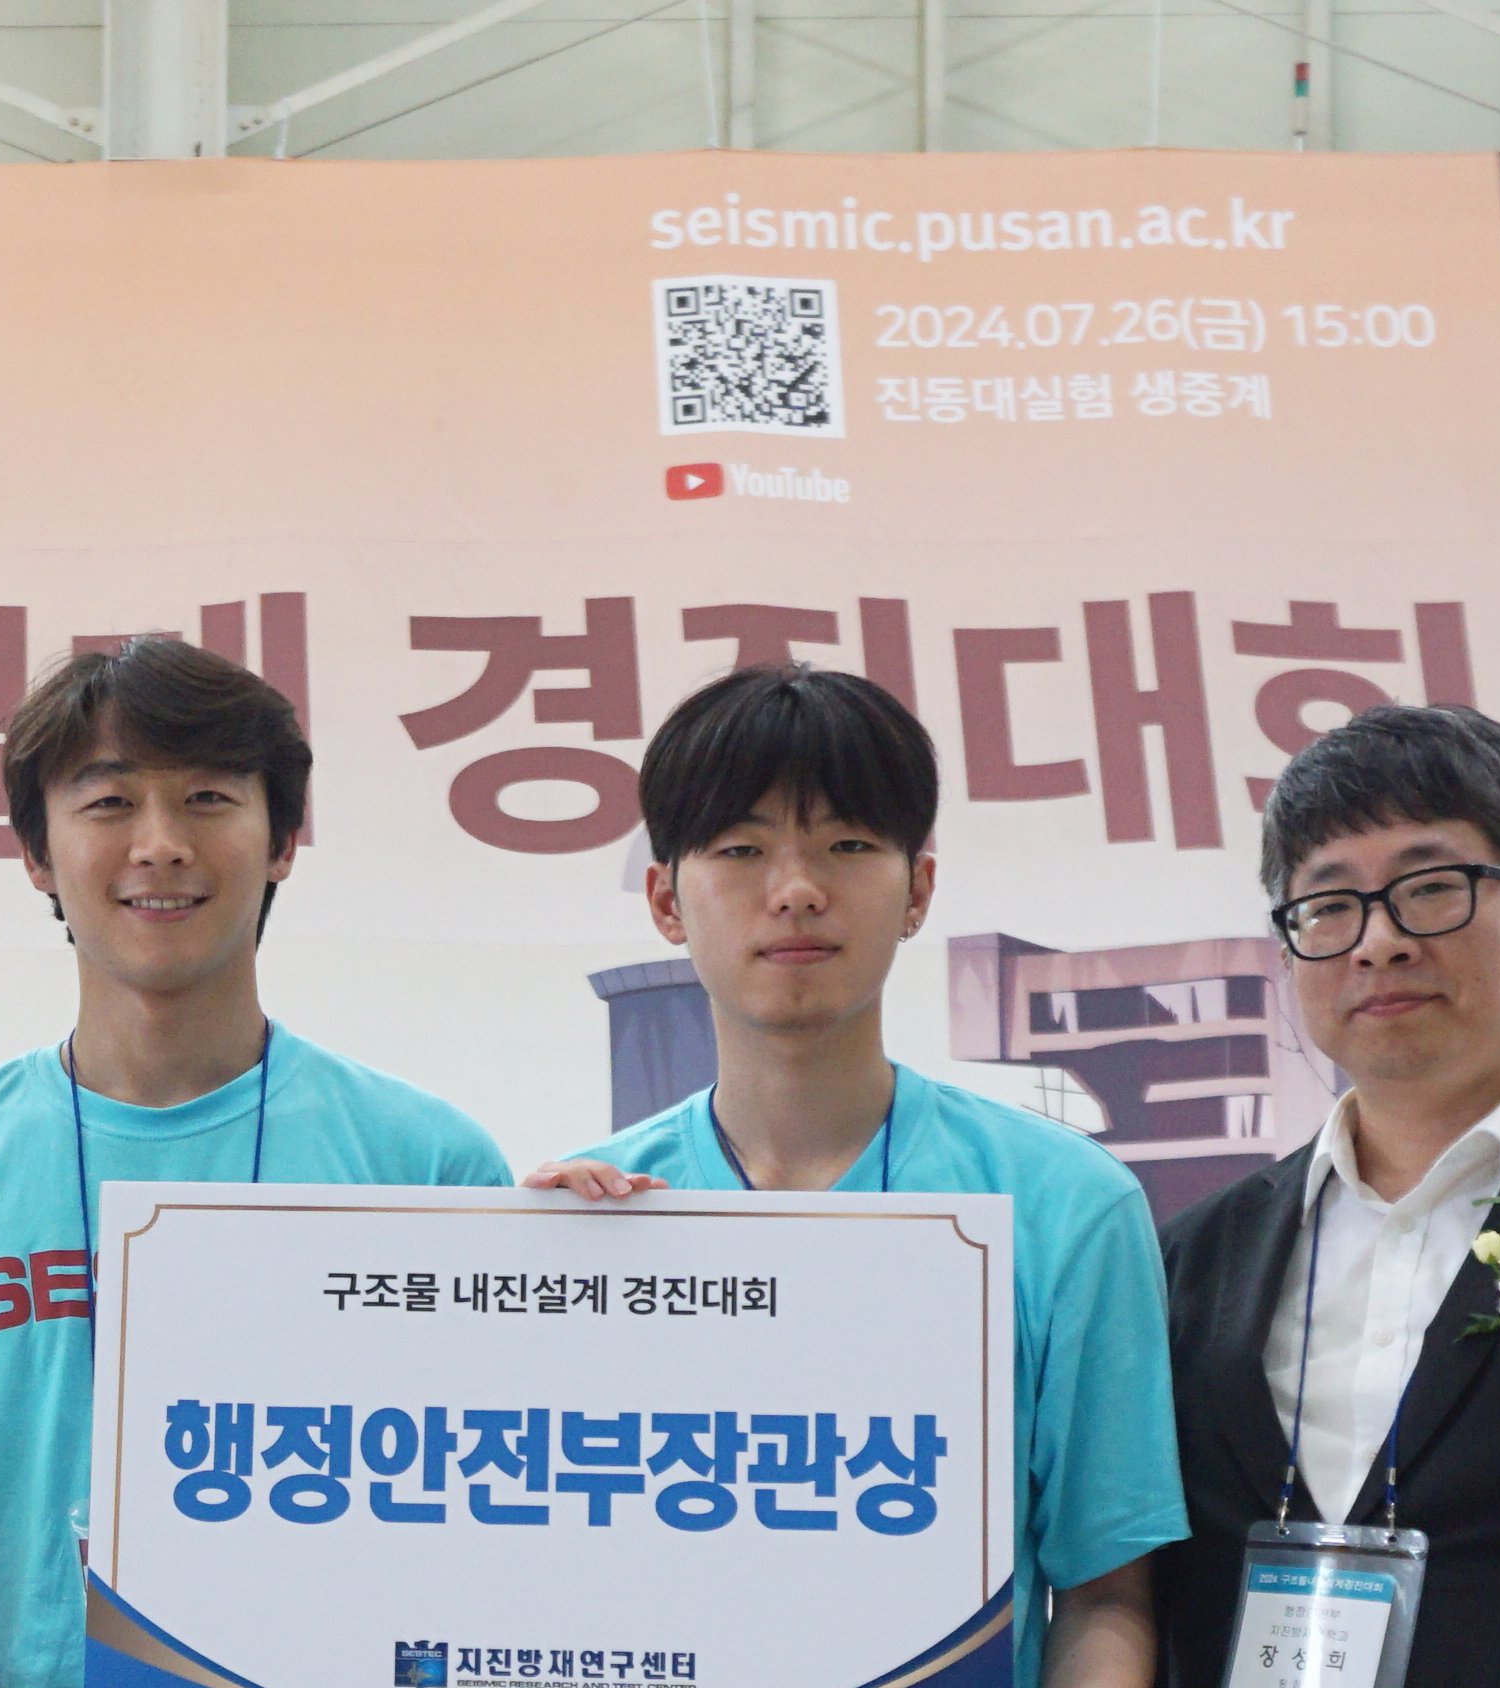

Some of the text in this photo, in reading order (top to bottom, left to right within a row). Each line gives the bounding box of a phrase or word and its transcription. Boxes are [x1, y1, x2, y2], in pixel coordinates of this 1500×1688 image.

[650, 192, 1296, 262] seismic.pusan.ac.kr
[876, 298, 1435, 354] 2024.07.26(금) 15:00
[876, 370, 1274, 423] 진동대실험 생중계
[728, 463, 852, 505] YouTube
[323, 1271, 779, 1318] 구조물 내진설계 경진대회
[163, 1399, 948, 1536] 행정안전부장관상
[401, 1649, 443, 1658] SESTEC
[457, 1647, 696, 1681] 지진방재연구센터
[457, 1680, 506, 1688] SEISMIC
[510, 1681, 577, 1688] RESEARCH
